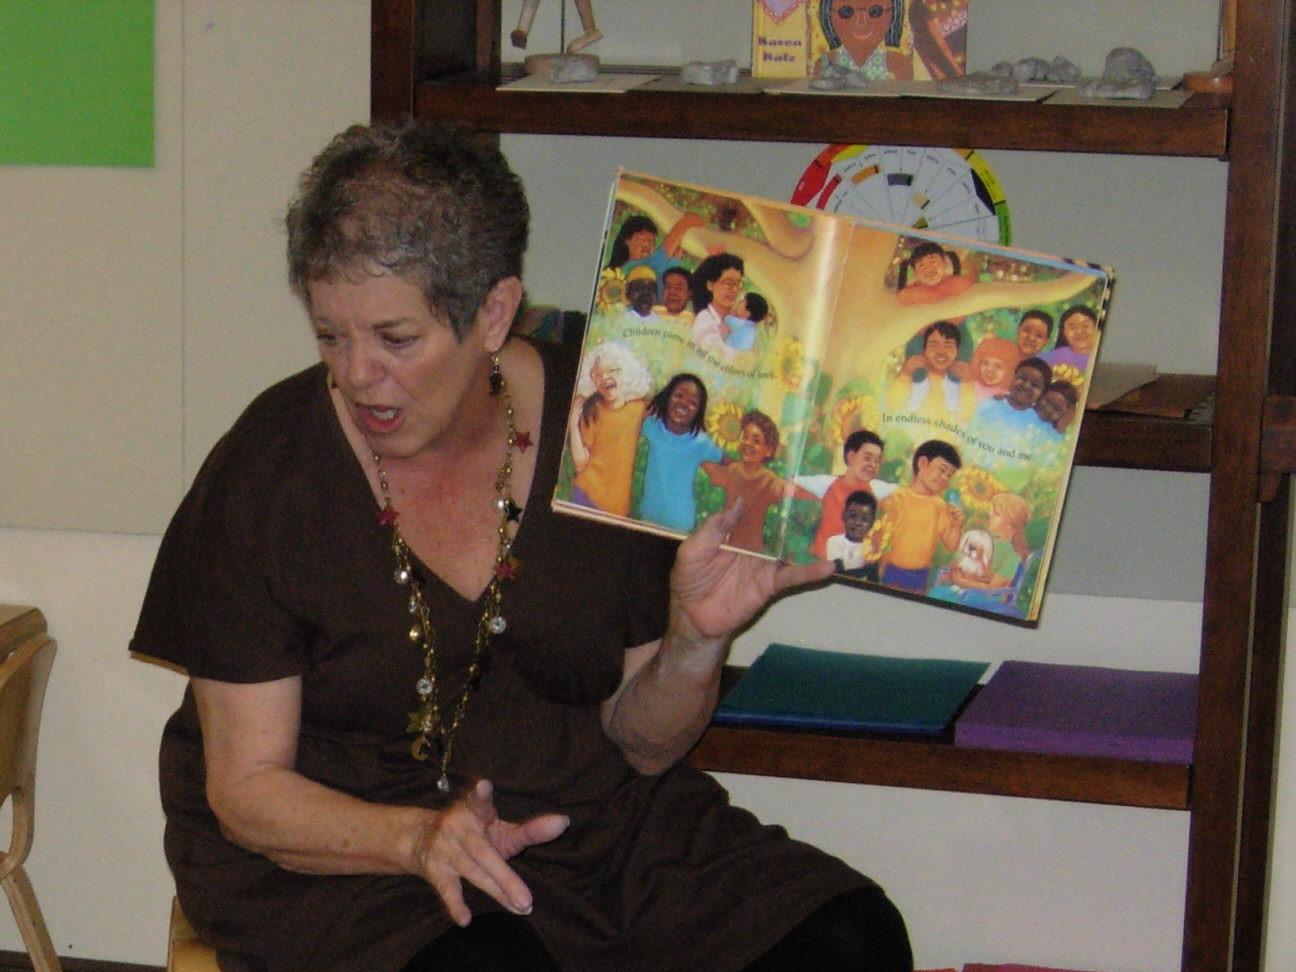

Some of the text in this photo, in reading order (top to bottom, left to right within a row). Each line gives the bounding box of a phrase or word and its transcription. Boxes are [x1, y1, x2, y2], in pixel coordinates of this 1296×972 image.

[758, 36, 801, 46] Karen
[762, 51, 795, 61] Katz
[623, 326, 661, 337] Children
[663, 330, 685, 343] come
[687, 339, 696, 349] in
[707, 354, 720, 367] the
[882, 413, 892, 423] In
[895, 413, 932, 425] endless
[934, 417, 966, 438] shades
[967, 435, 978, 446] of
[978, 440, 996, 453] you
[997, 448, 1016, 459] and
